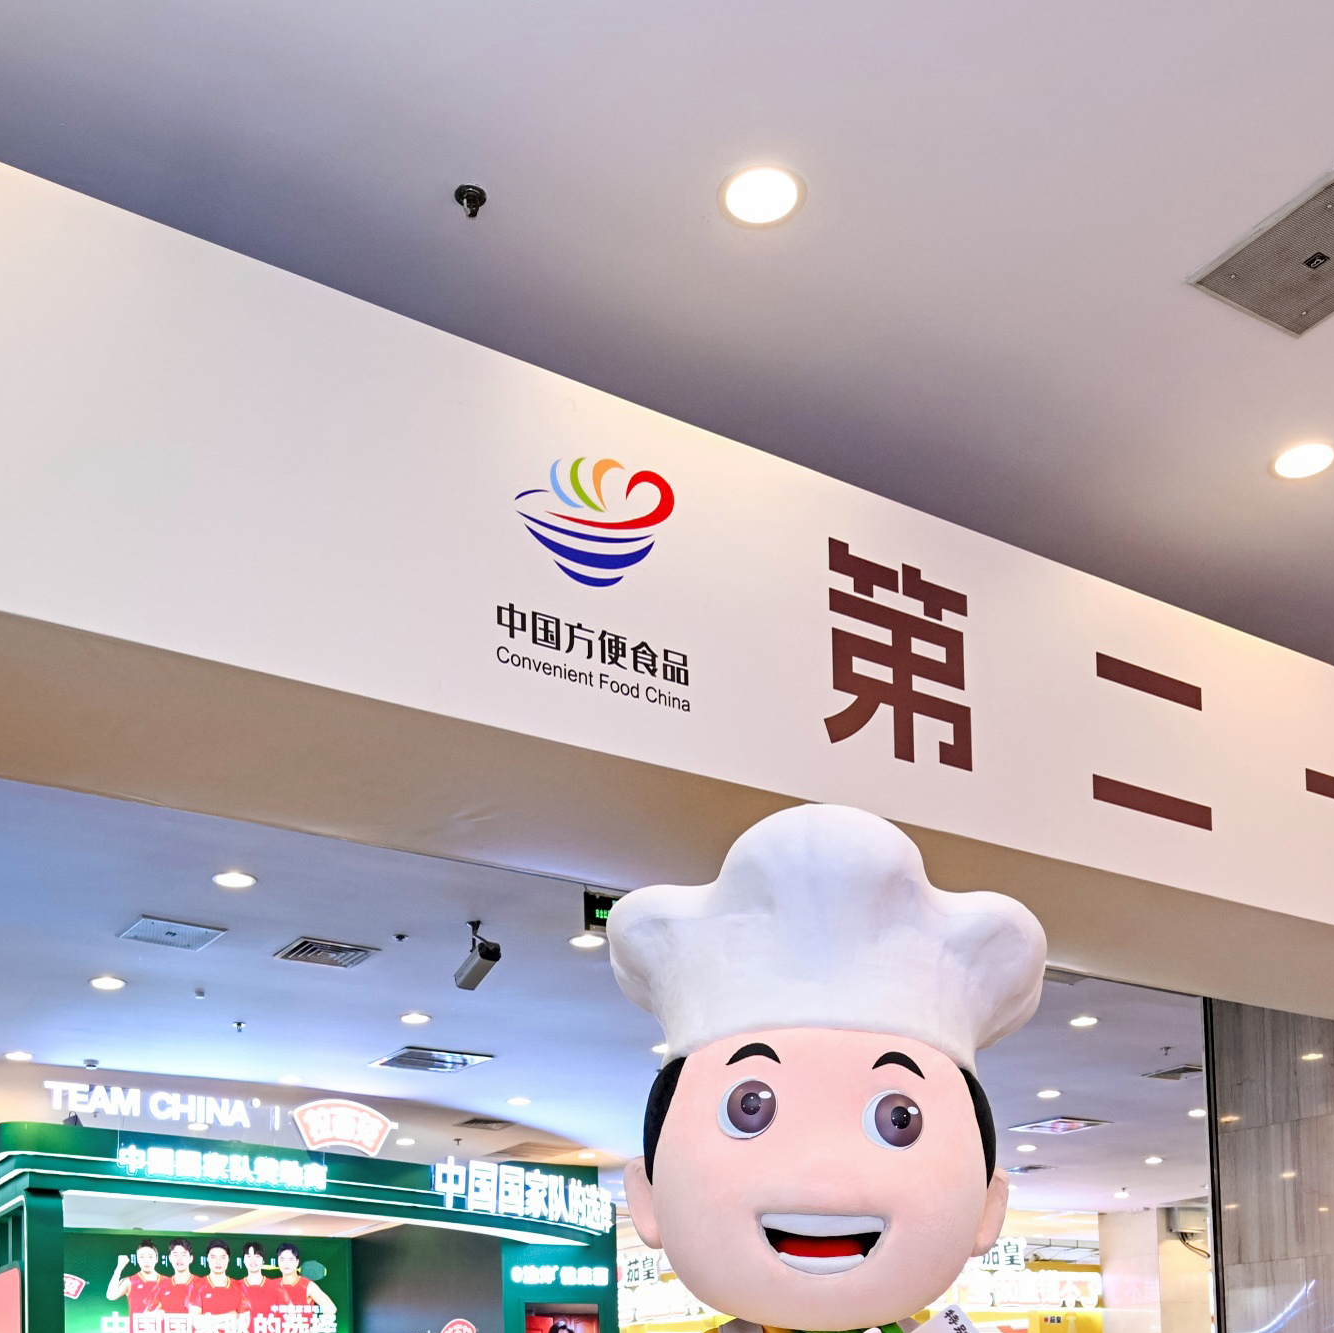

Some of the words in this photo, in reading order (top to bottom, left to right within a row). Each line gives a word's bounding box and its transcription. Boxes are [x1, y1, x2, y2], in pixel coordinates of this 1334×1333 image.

[496, 602, 689, 686] 中国方便食品
[496, 646, 594, 687] Convenient
[599, 672, 640, 699] Food
[645, 686, 691, 712] China
[43, 1080, 141, 1117] TEAM
[148, 1091, 251, 1128] CHINA
[434, 1155, 615, 1233] 中国国家队的选择
